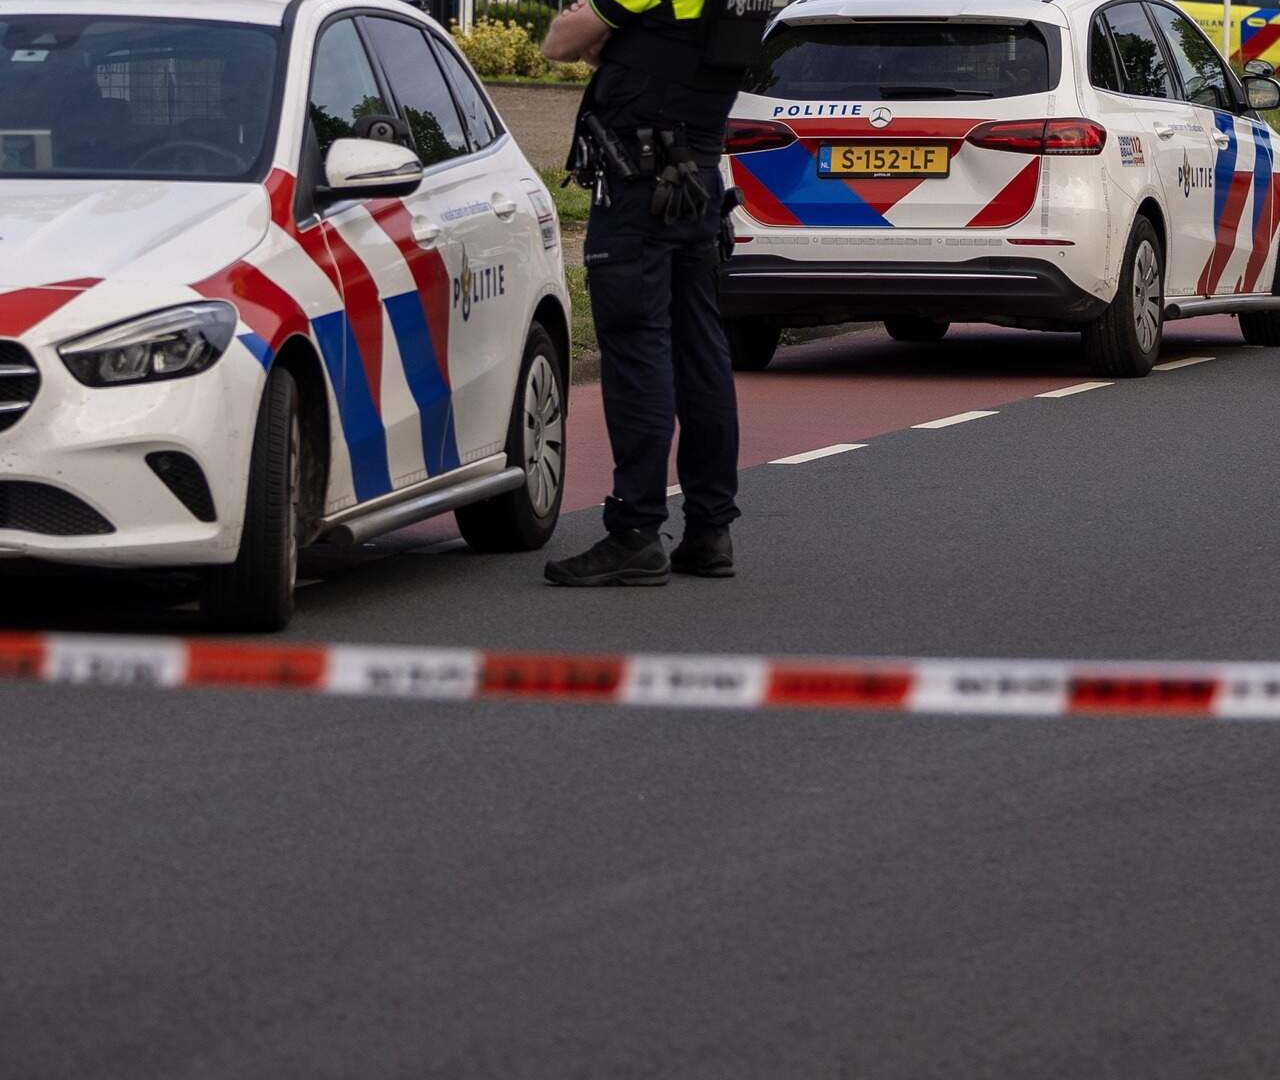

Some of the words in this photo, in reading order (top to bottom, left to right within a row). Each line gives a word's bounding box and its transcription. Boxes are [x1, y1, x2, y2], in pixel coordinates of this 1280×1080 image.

[773, 104, 862, 117] POLITIE
[841, 148, 935, 170] S-152-LF
[1178, 164, 1212, 196] POLITIE
[453, 262, 505, 320] POLITIE
